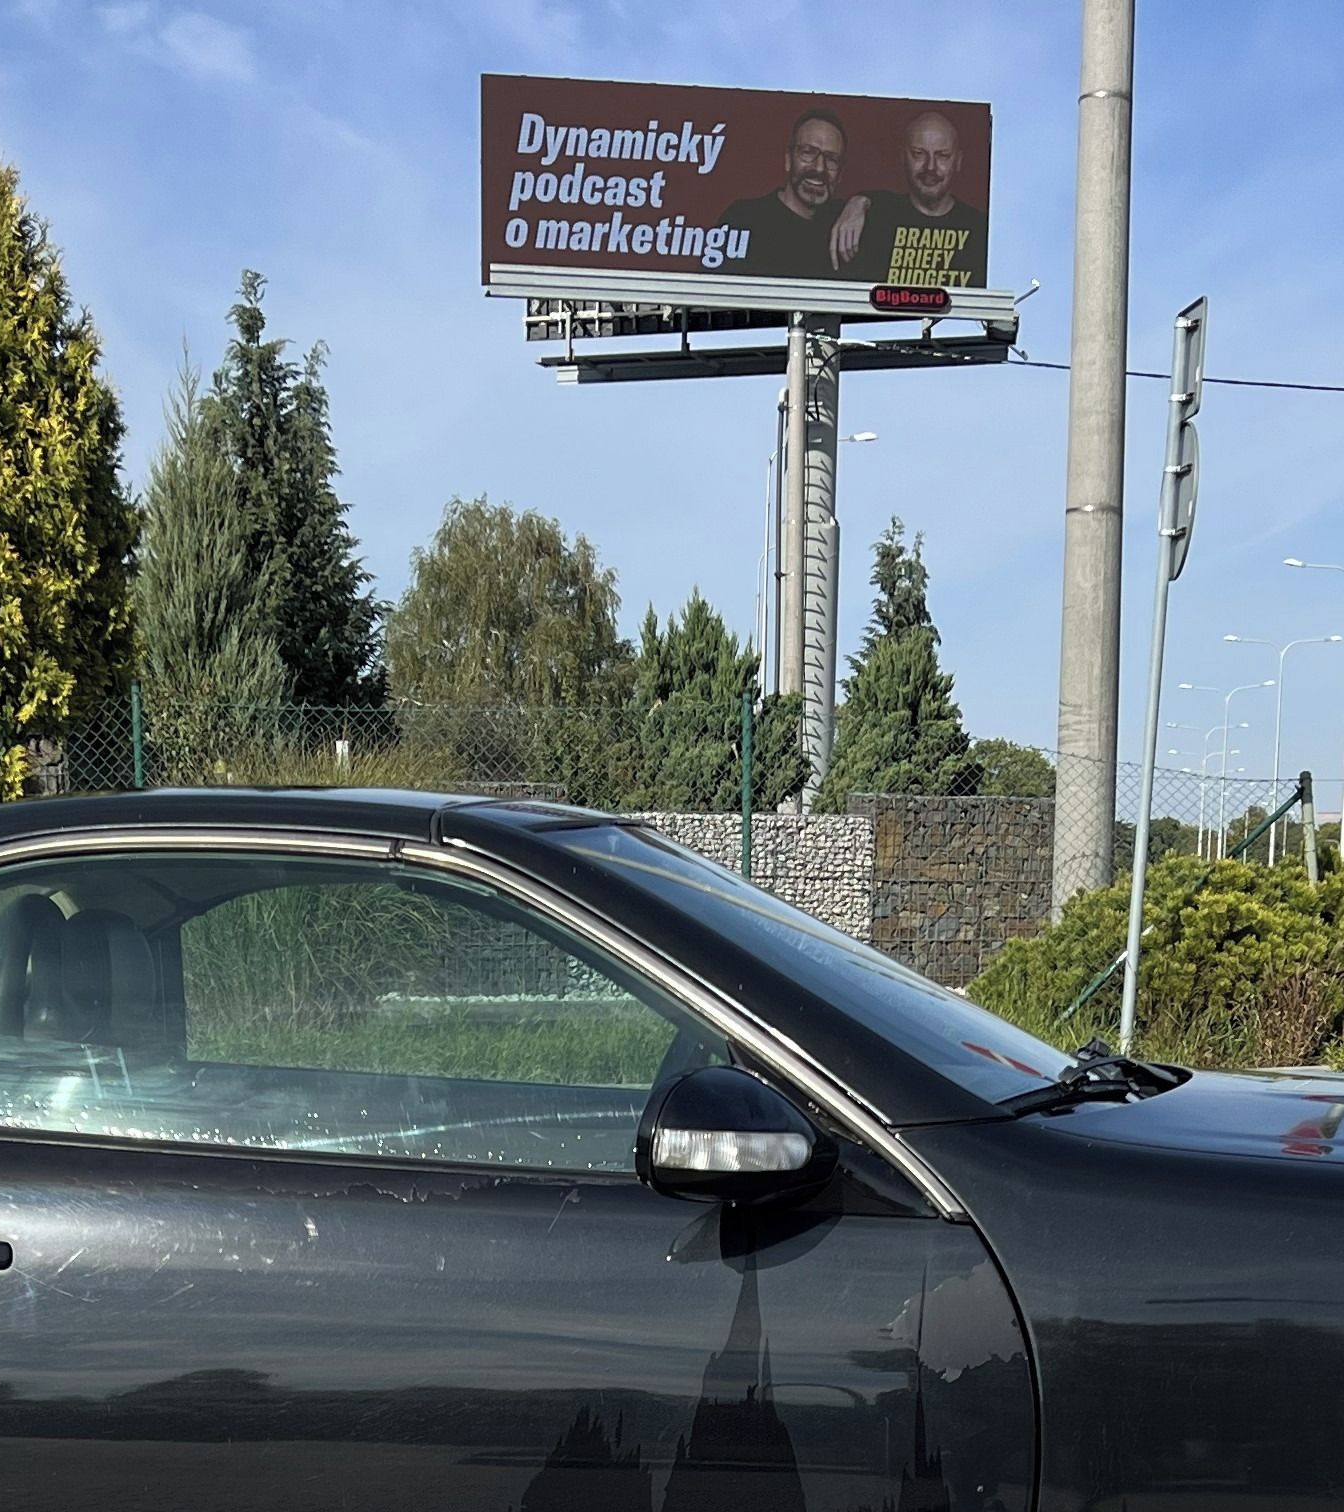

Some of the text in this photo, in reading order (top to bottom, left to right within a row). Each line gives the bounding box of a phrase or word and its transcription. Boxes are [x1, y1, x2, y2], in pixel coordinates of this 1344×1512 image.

[517, 112, 727, 174] Dynamický
[508, 162, 666, 211] podcast
[505, 211, 751, 268] o marketingu
[894, 226, 970, 250] BRANDY
[890, 247, 955, 270] BRIEFY
[875, 289, 945, 305] BigBoard
